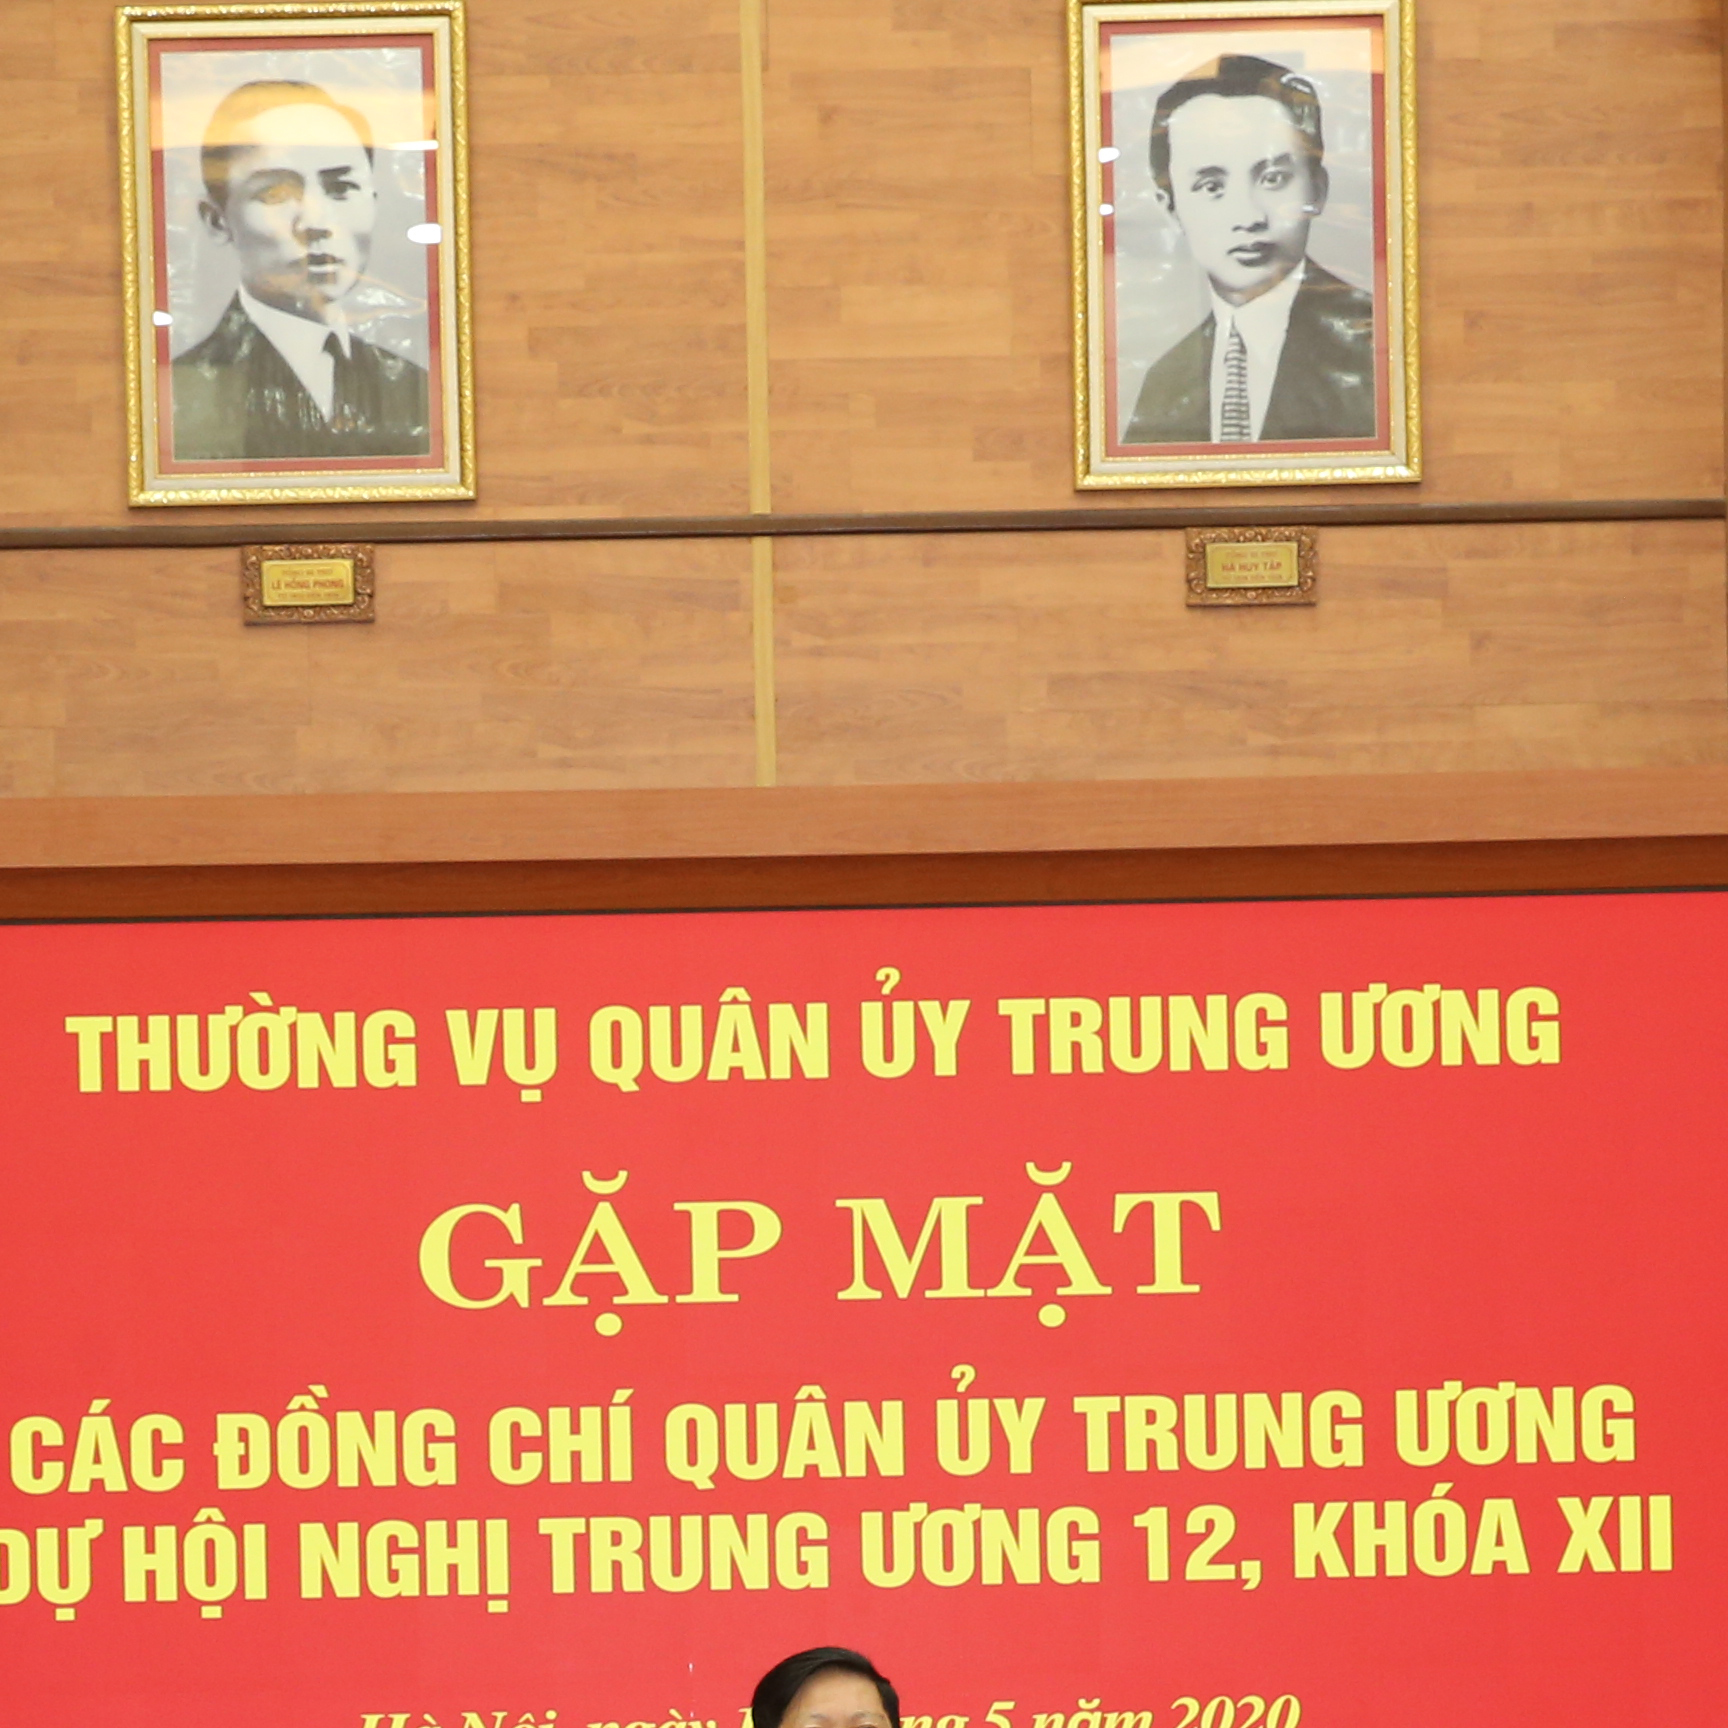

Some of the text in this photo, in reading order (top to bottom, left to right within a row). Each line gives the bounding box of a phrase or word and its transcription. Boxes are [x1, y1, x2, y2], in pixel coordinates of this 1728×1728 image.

[65, 967, 1560, 1102] THƯỜNG VỤ QUÂN ỦY TRUNG ƯƠNG
[419, 1162, 1221, 1336] GẶP MẶT
[10, 1364, 1635, 1494] CÁC ĐỒNG CHÍ QUÂN ỦY TRUNG ƯƠNG
[123, 1508, 267, 1618] HỘI
[300, 1519, 509, 1613] NGHỊ
[539, 1512, 829, 1593] TRUNG
[861, 1502, 1100, 1588] ƯƠNG
[1134, 1505, 1261, 1590] 12,
[1294, 1483, 1530, 1578] KHÓA
[1557, 1495, 1672, 1573] XII
